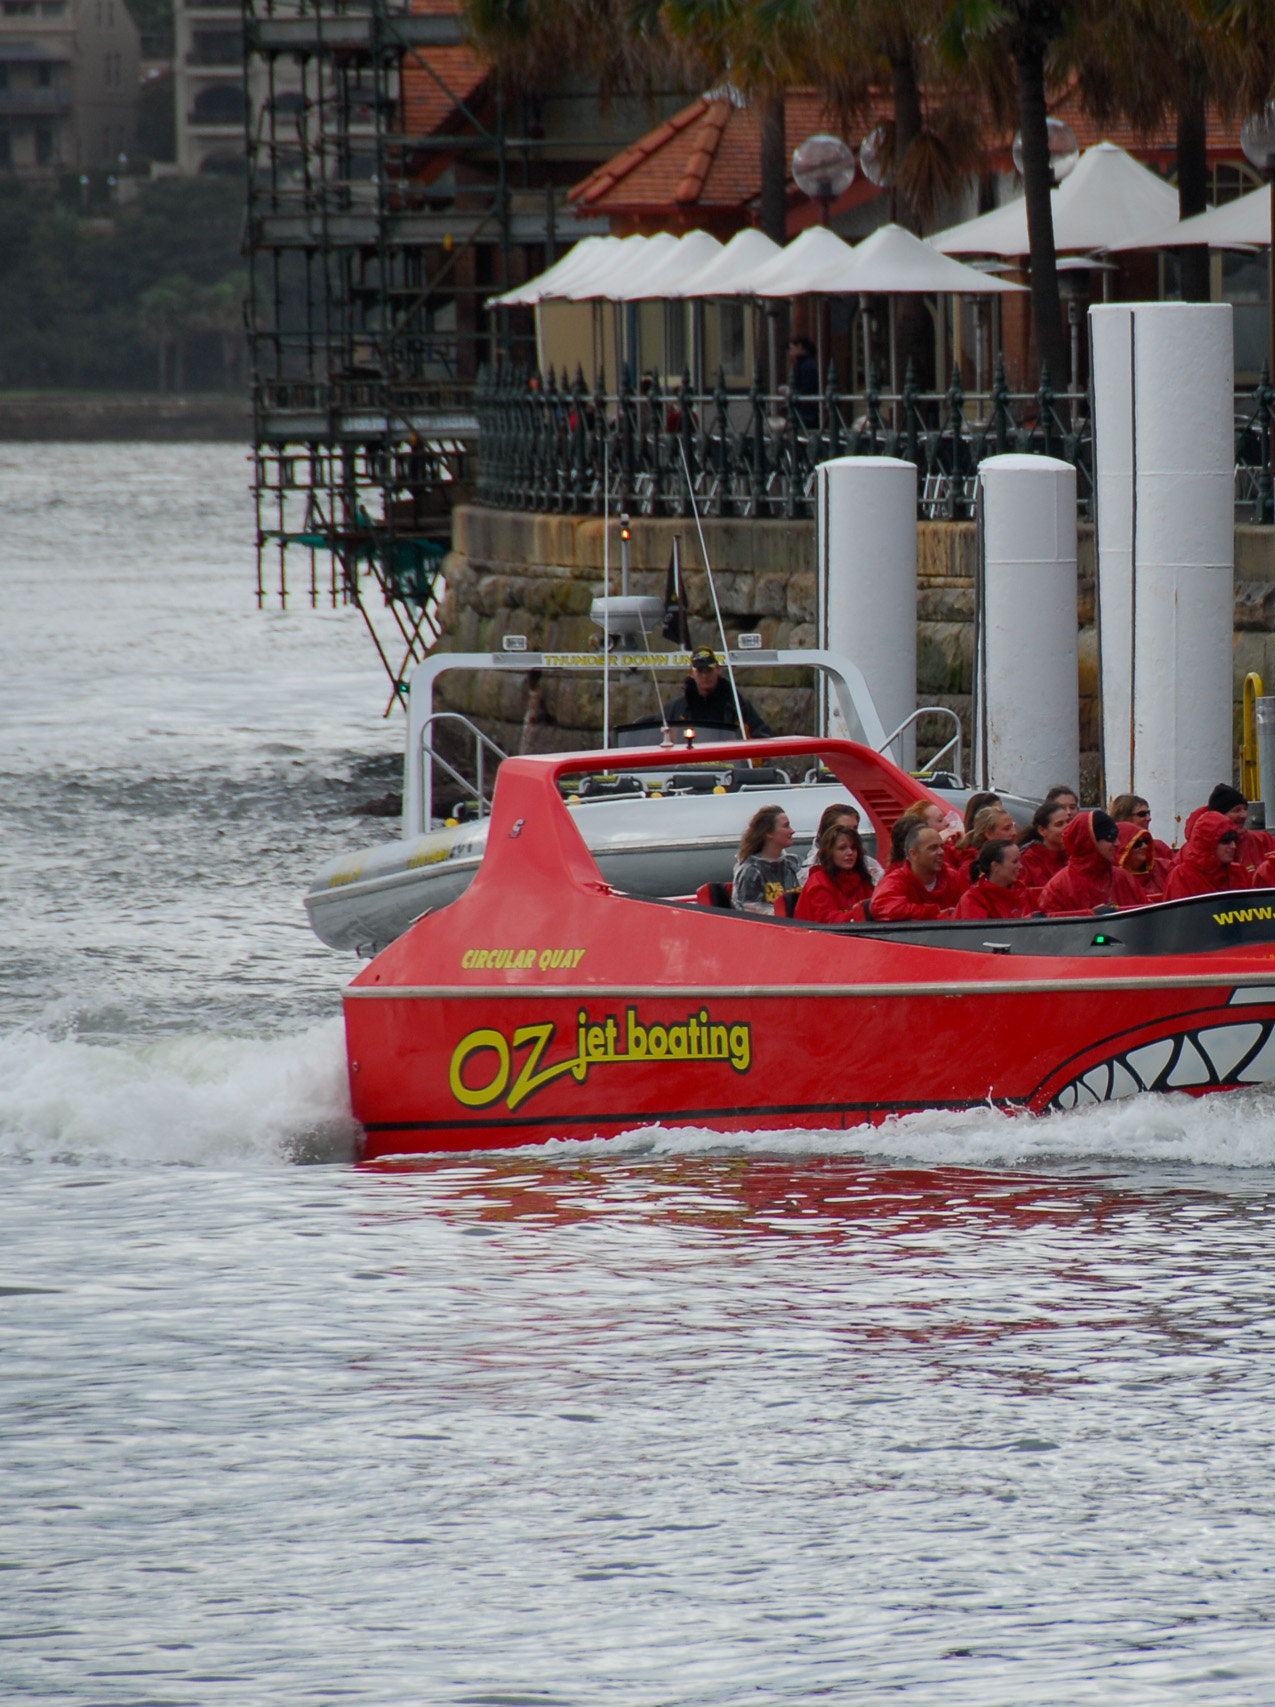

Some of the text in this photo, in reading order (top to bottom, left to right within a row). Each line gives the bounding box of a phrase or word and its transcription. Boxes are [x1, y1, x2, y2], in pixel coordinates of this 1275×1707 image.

[544, 655, 618, 666] THUNDER
[621, 655, 669, 666] DOWN
[672, 655, 726, 665] UNR
[461, 949, 586, 971] CIRCULAR QUAY
[450, 1009, 750, 1110] OZ jet boating
